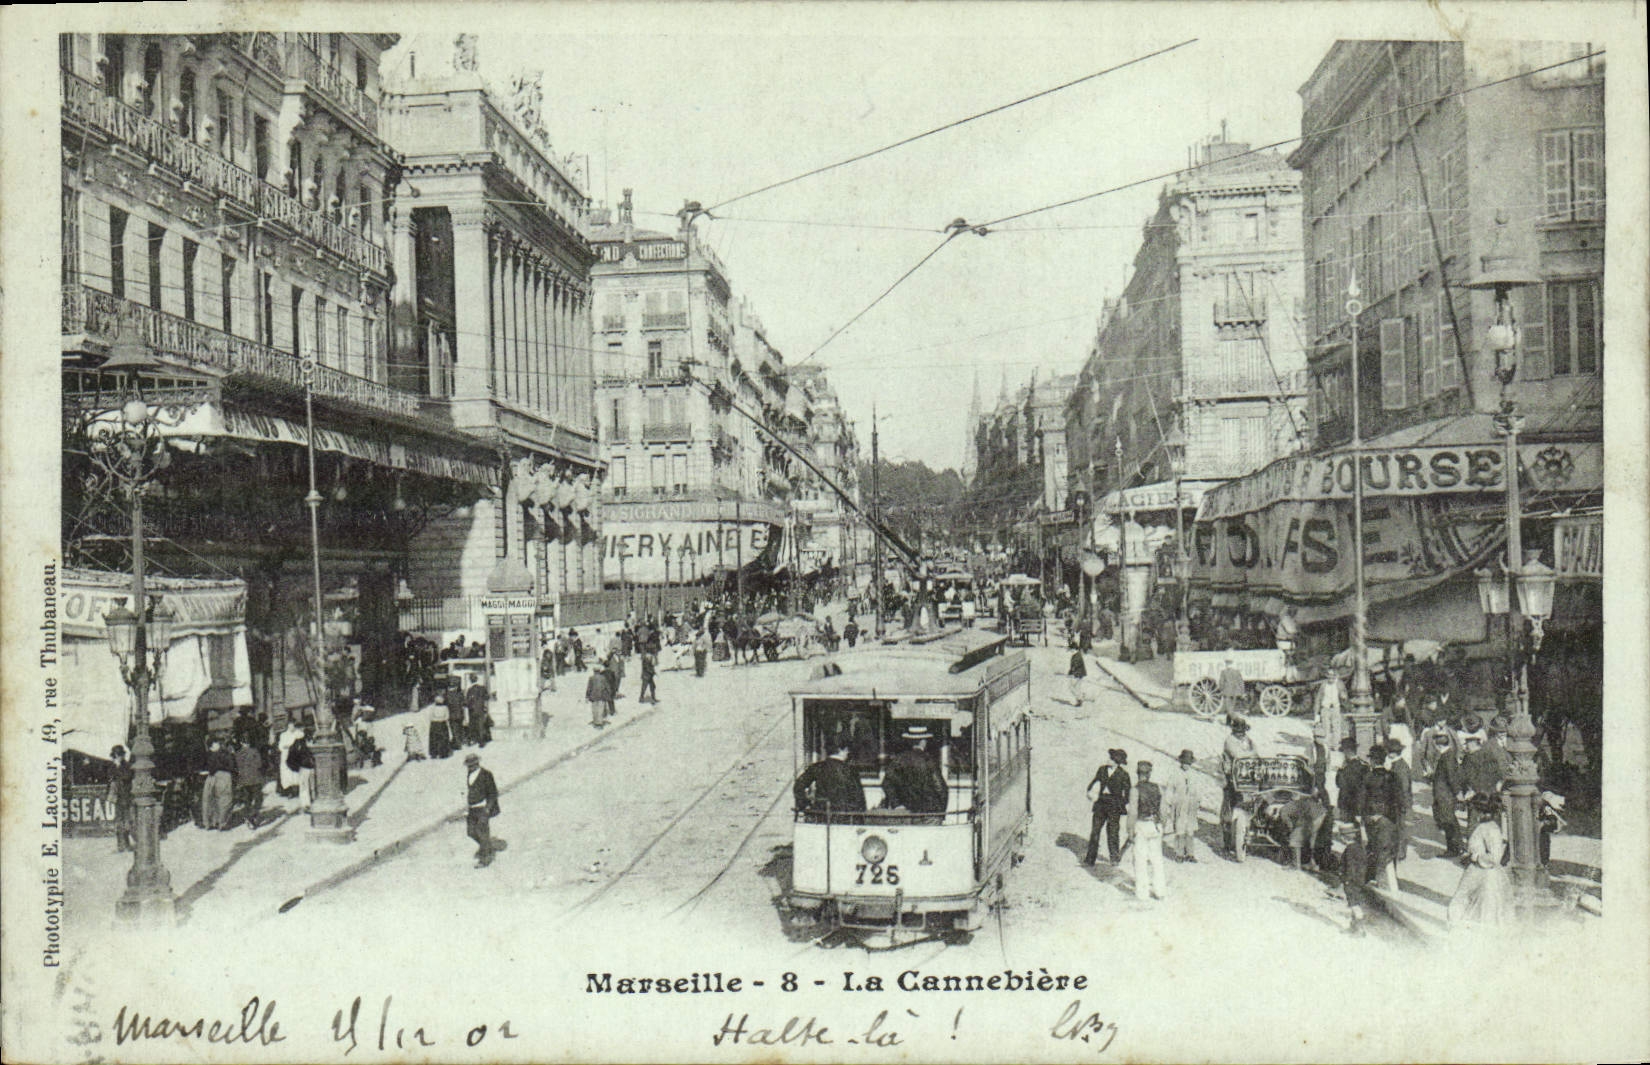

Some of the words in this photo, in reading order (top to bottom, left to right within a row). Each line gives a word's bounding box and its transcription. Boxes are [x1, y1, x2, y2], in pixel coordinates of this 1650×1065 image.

[1321, 449, 1503, 495] BOURSE
[481, 600, 505, 610] MAGGI
[508, 599, 537, 610] MAGGI
[856, 864, 900, 885] 725
